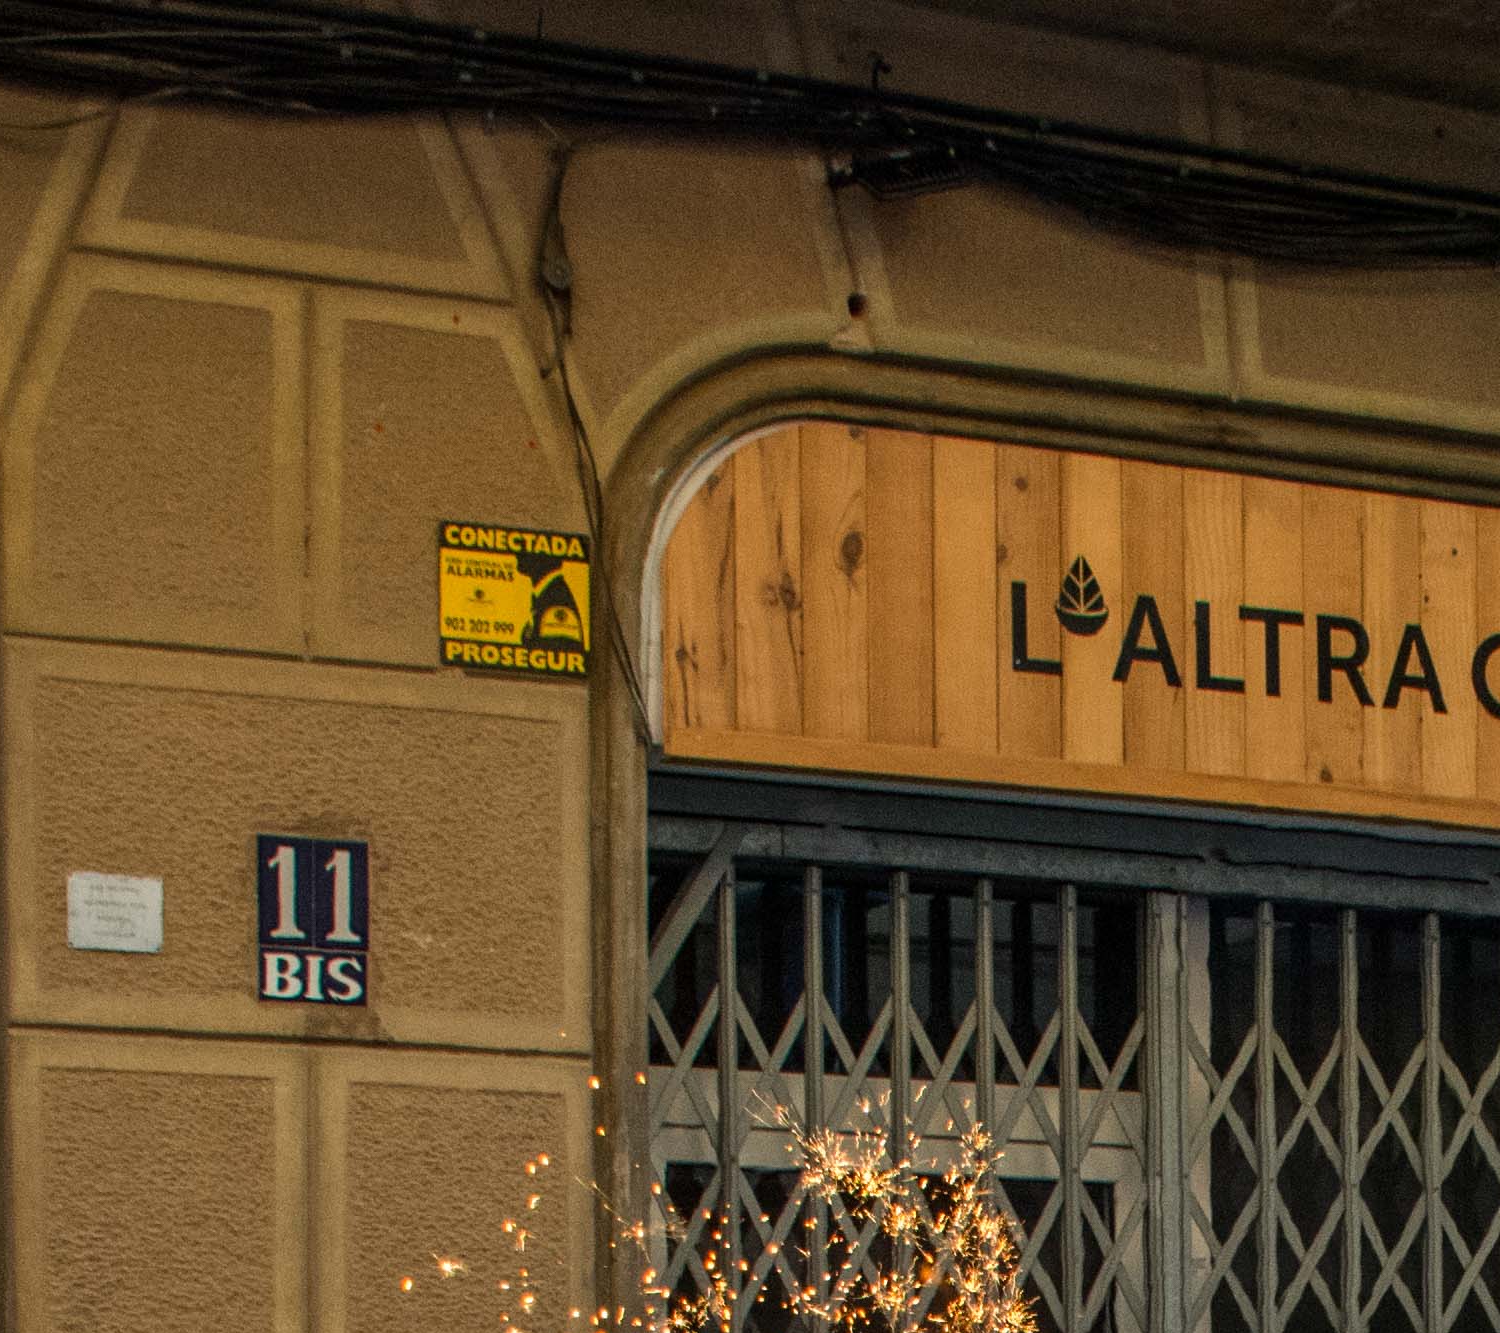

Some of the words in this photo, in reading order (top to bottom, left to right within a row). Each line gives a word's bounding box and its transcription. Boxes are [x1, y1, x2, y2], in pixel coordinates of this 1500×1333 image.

[444, 523, 585, 558] CONECTADA
[446, 564, 515, 582] ALARMAS
[446, 638, 586, 673] PROSEGUR
[267, 845, 362, 943] 11
[262, 952, 363, 1003] BIS
